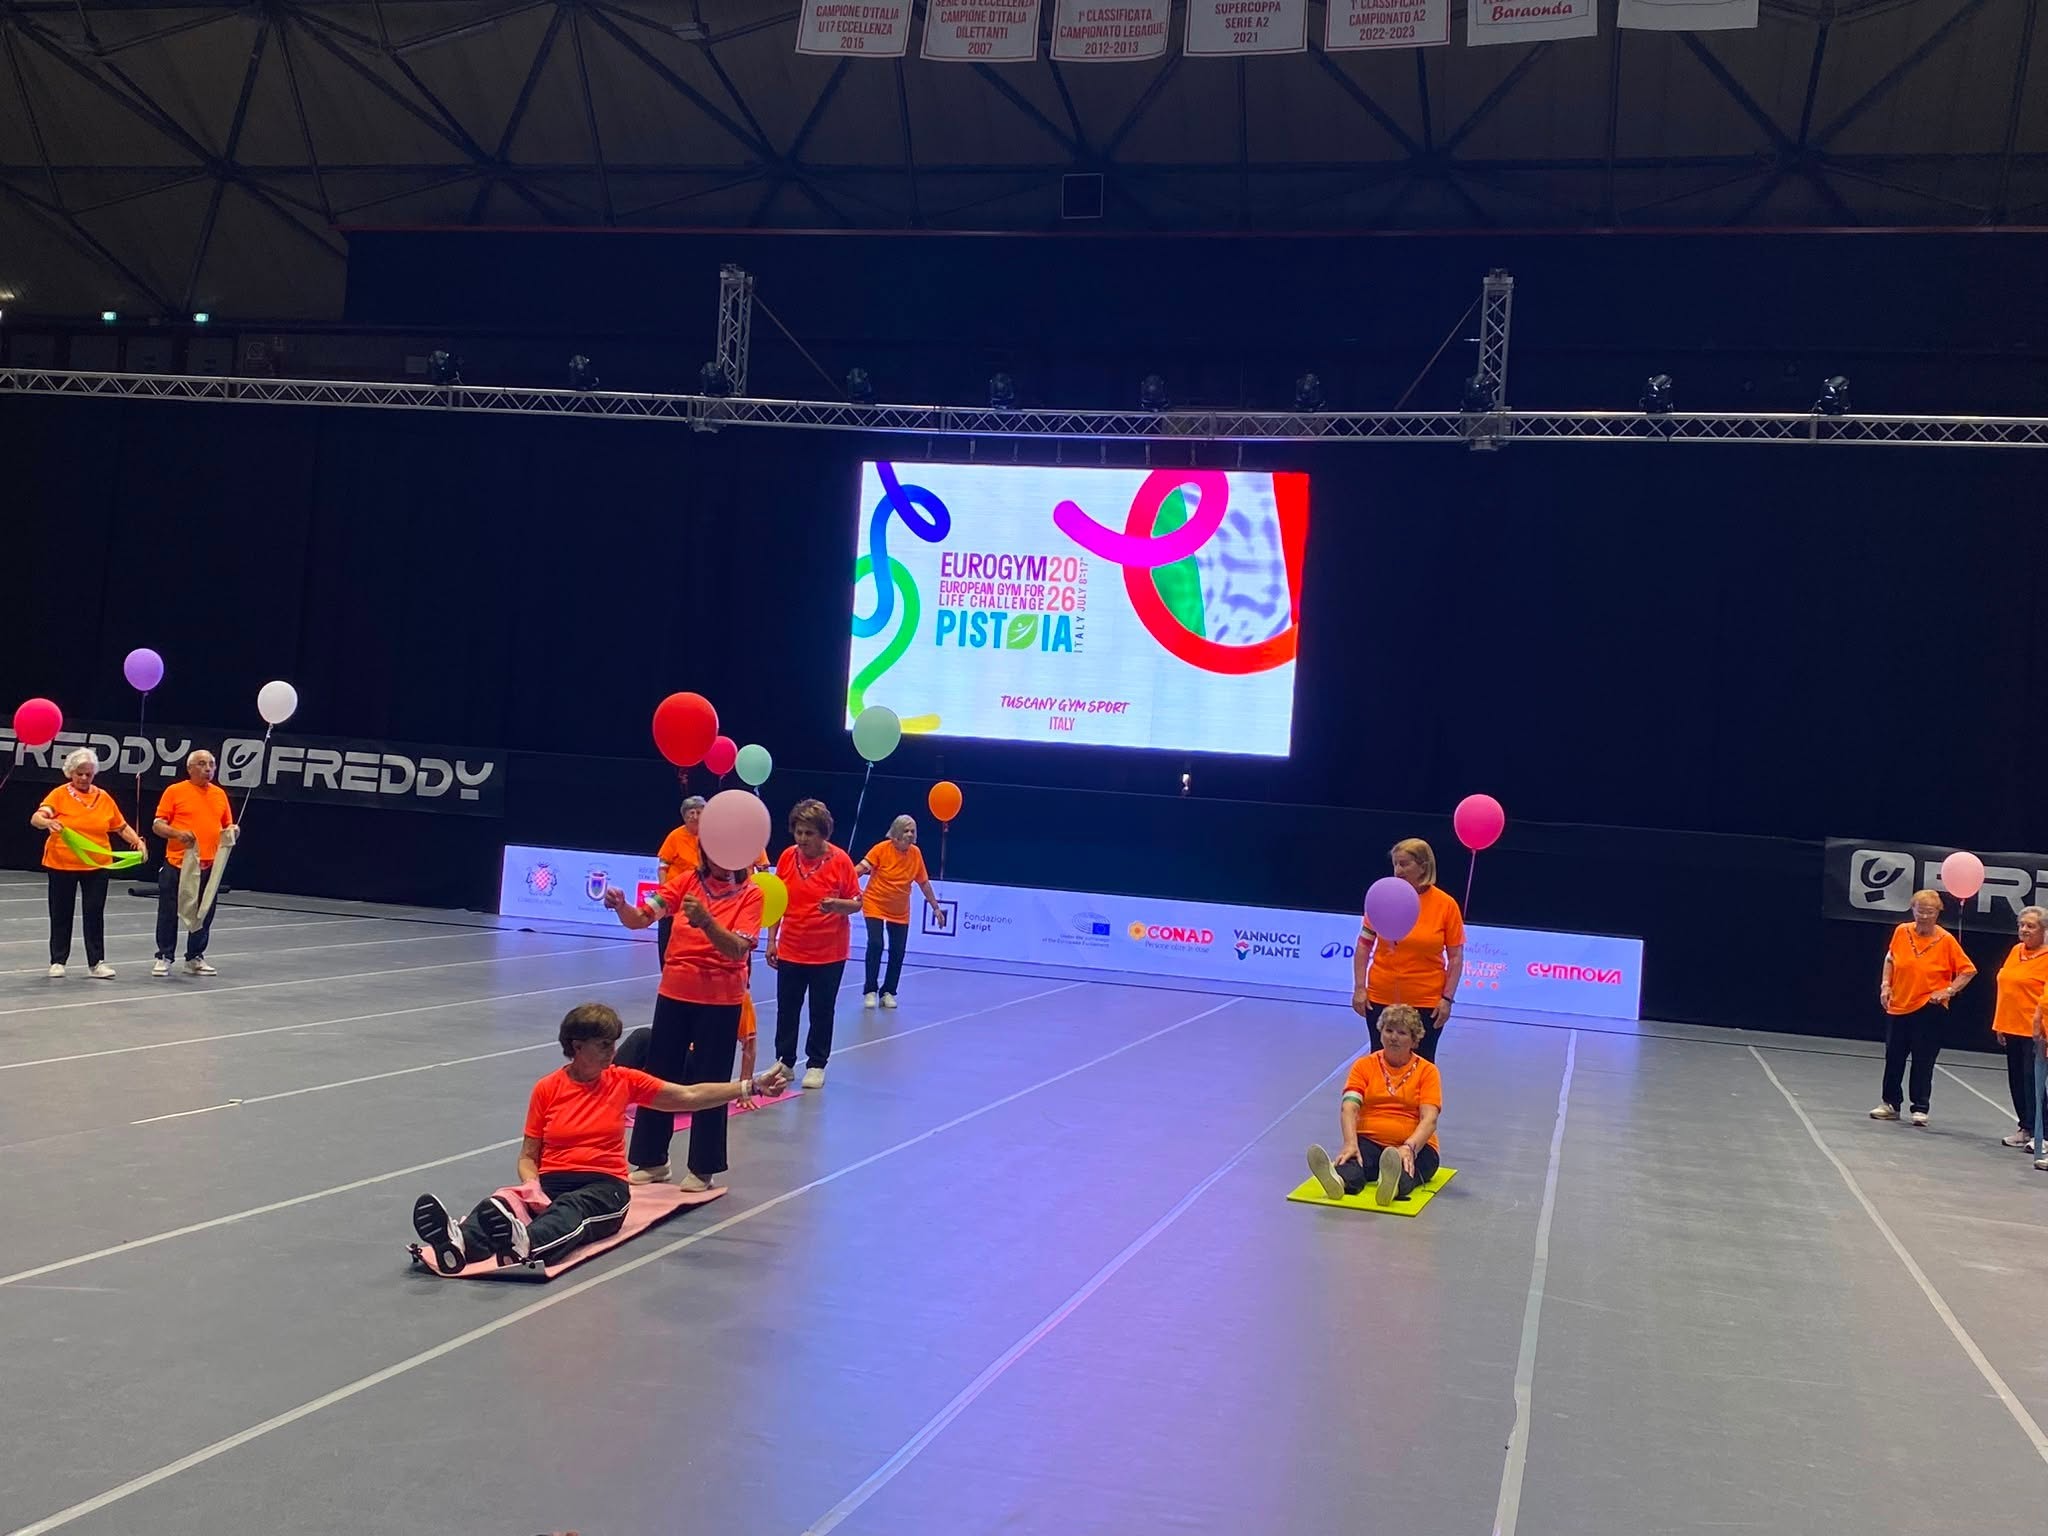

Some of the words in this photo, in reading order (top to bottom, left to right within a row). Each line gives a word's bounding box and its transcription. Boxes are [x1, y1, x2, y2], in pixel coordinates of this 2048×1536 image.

[816, 5, 860, 18] CAMPIONE
[862, 7, 899, 19] D'ITALIA
[1086, 9, 1152, 22] CLASSIFICATA
[1215, 2, 1281, 14] SUPERCOPPA
[1492, 2, 1572, 21] Baraonda
[941, 9, 987, 23] CAMPIONE
[989, 11, 1027, 23] D'ITALIA
[1225, 17, 1252, 29] SERIE
[1255, 17, 1270, 28] A2
[1349, 12, 1411, 26] CAMPIONATO
[1414, 9, 1426, 21] A2
[818, 21, 836, 33] U17
[837, 21, 892, 34] ECCELLENZA
[956, 26, 1008, 39] DILETTANTI
[1060, 24, 1122, 39] CAMPIONATO
[1360, 26, 1416, 41] 2022-2023
[1233, 32, 1258, 43] 2021
[968, 42, 992, 55] 2007
[1084, 41, 1139, 55] 2012-2013
[940, 552, 1048, 581] EUROGYM
[1048, 556, 1078, 583] 20
[939, 580, 994, 595] EUROPEAN
[997, 583, 1021, 597] GYM
[1024, 585, 1045, 597] FOR
[938, 594, 965, 607] LIFE
[970, 595, 1045, 611] CHALLENGE
[1046, 586, 1076, 612] 26
[1077, 587, 1087, 612] JULY
[1074, 616, 1086, 653] ITALY
[1001, 695, 1057, 711] TUSCANY
[1058, 698, 1085, 712] GYM
[1087, 700, 1131, 714] SPORT
[1049, 716, 1075, 731] ITALY
[267, 745, 495, 801] FREDDY
[964, 911, 1013, 924] Fondazione
[963, 921, 992, 932] Caript
[1147, 925, 1214, 945] CONAD
[1233, 928, 1301, 945] VANNUCCI
[1252, 944, 1300, 959] PIANTE
[1527, 962, 1622, 985] GYMNOVA
